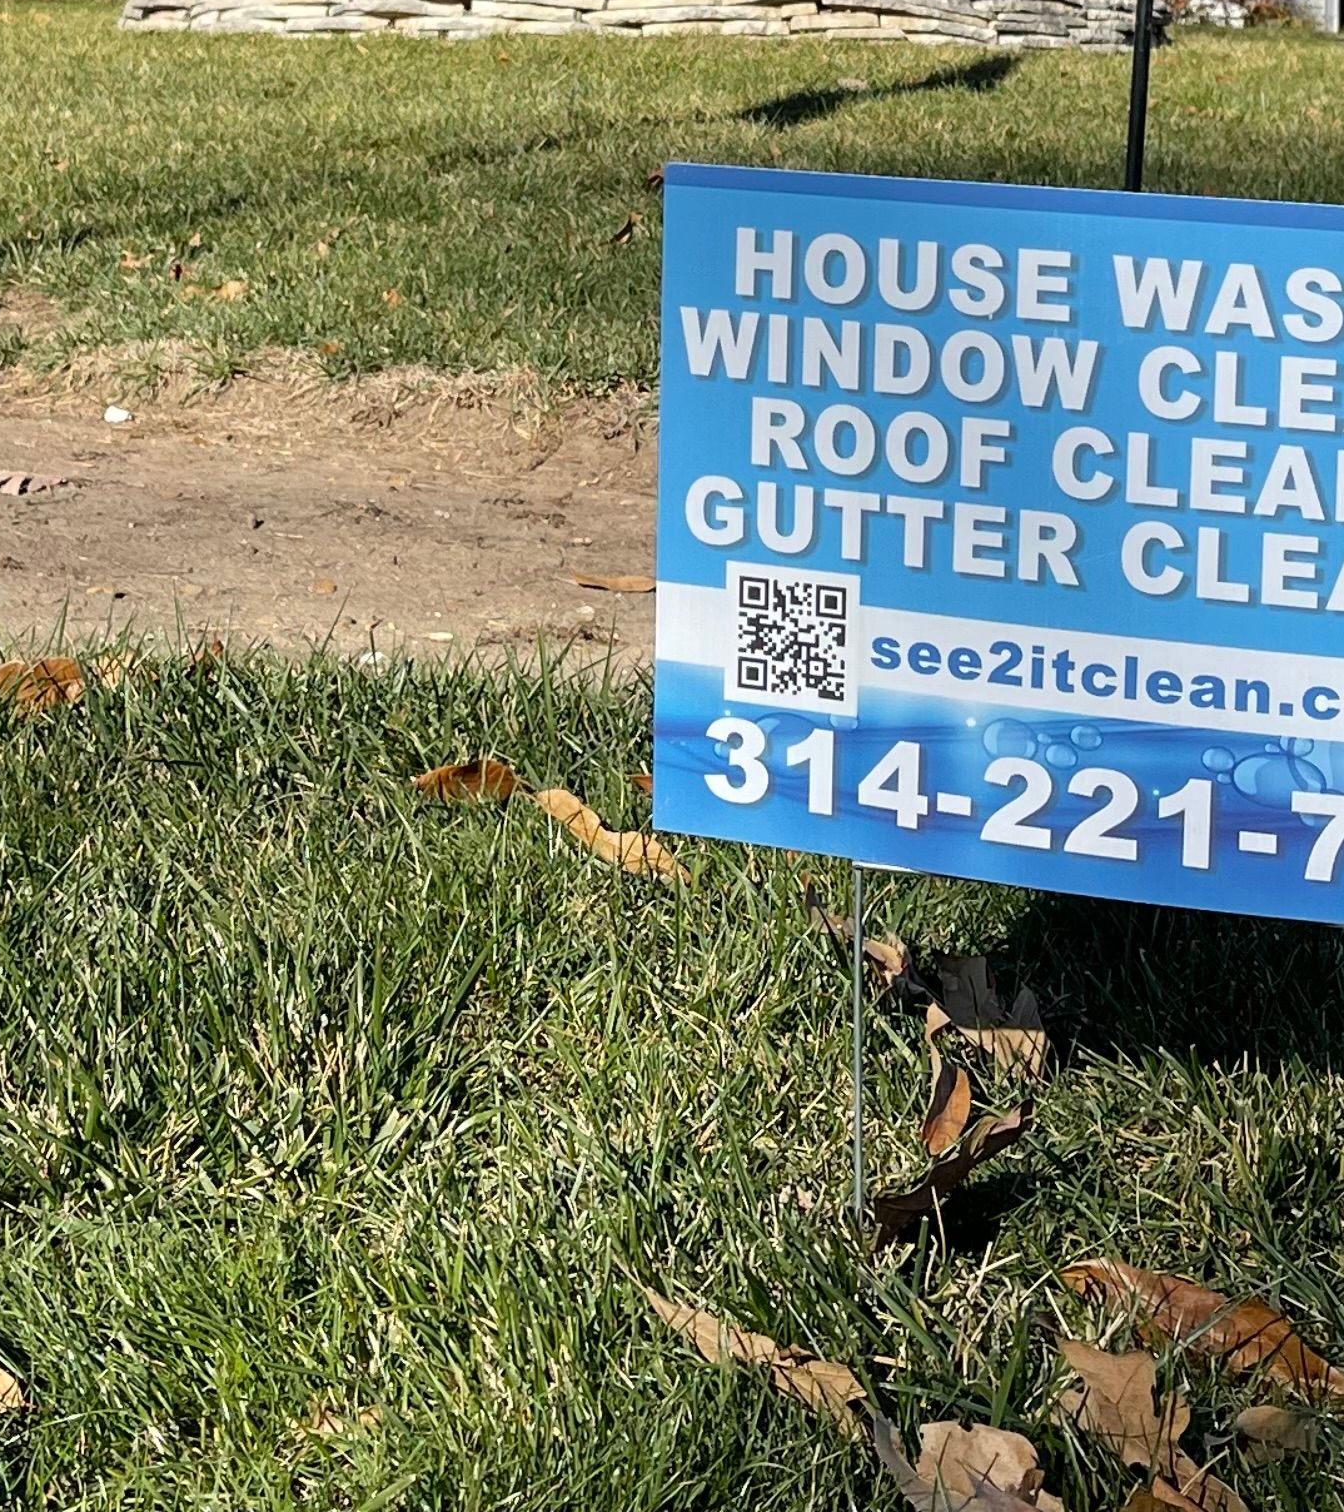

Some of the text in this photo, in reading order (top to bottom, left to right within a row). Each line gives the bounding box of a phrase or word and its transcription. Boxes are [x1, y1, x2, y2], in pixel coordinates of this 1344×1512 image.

[736, 228, 1071, 321] HOUSE
[681, 307, 1098, 410] WINDOW
[752, 397, 1010, 488] ROOF
[686, 476, 1079, 586] GUTTER
